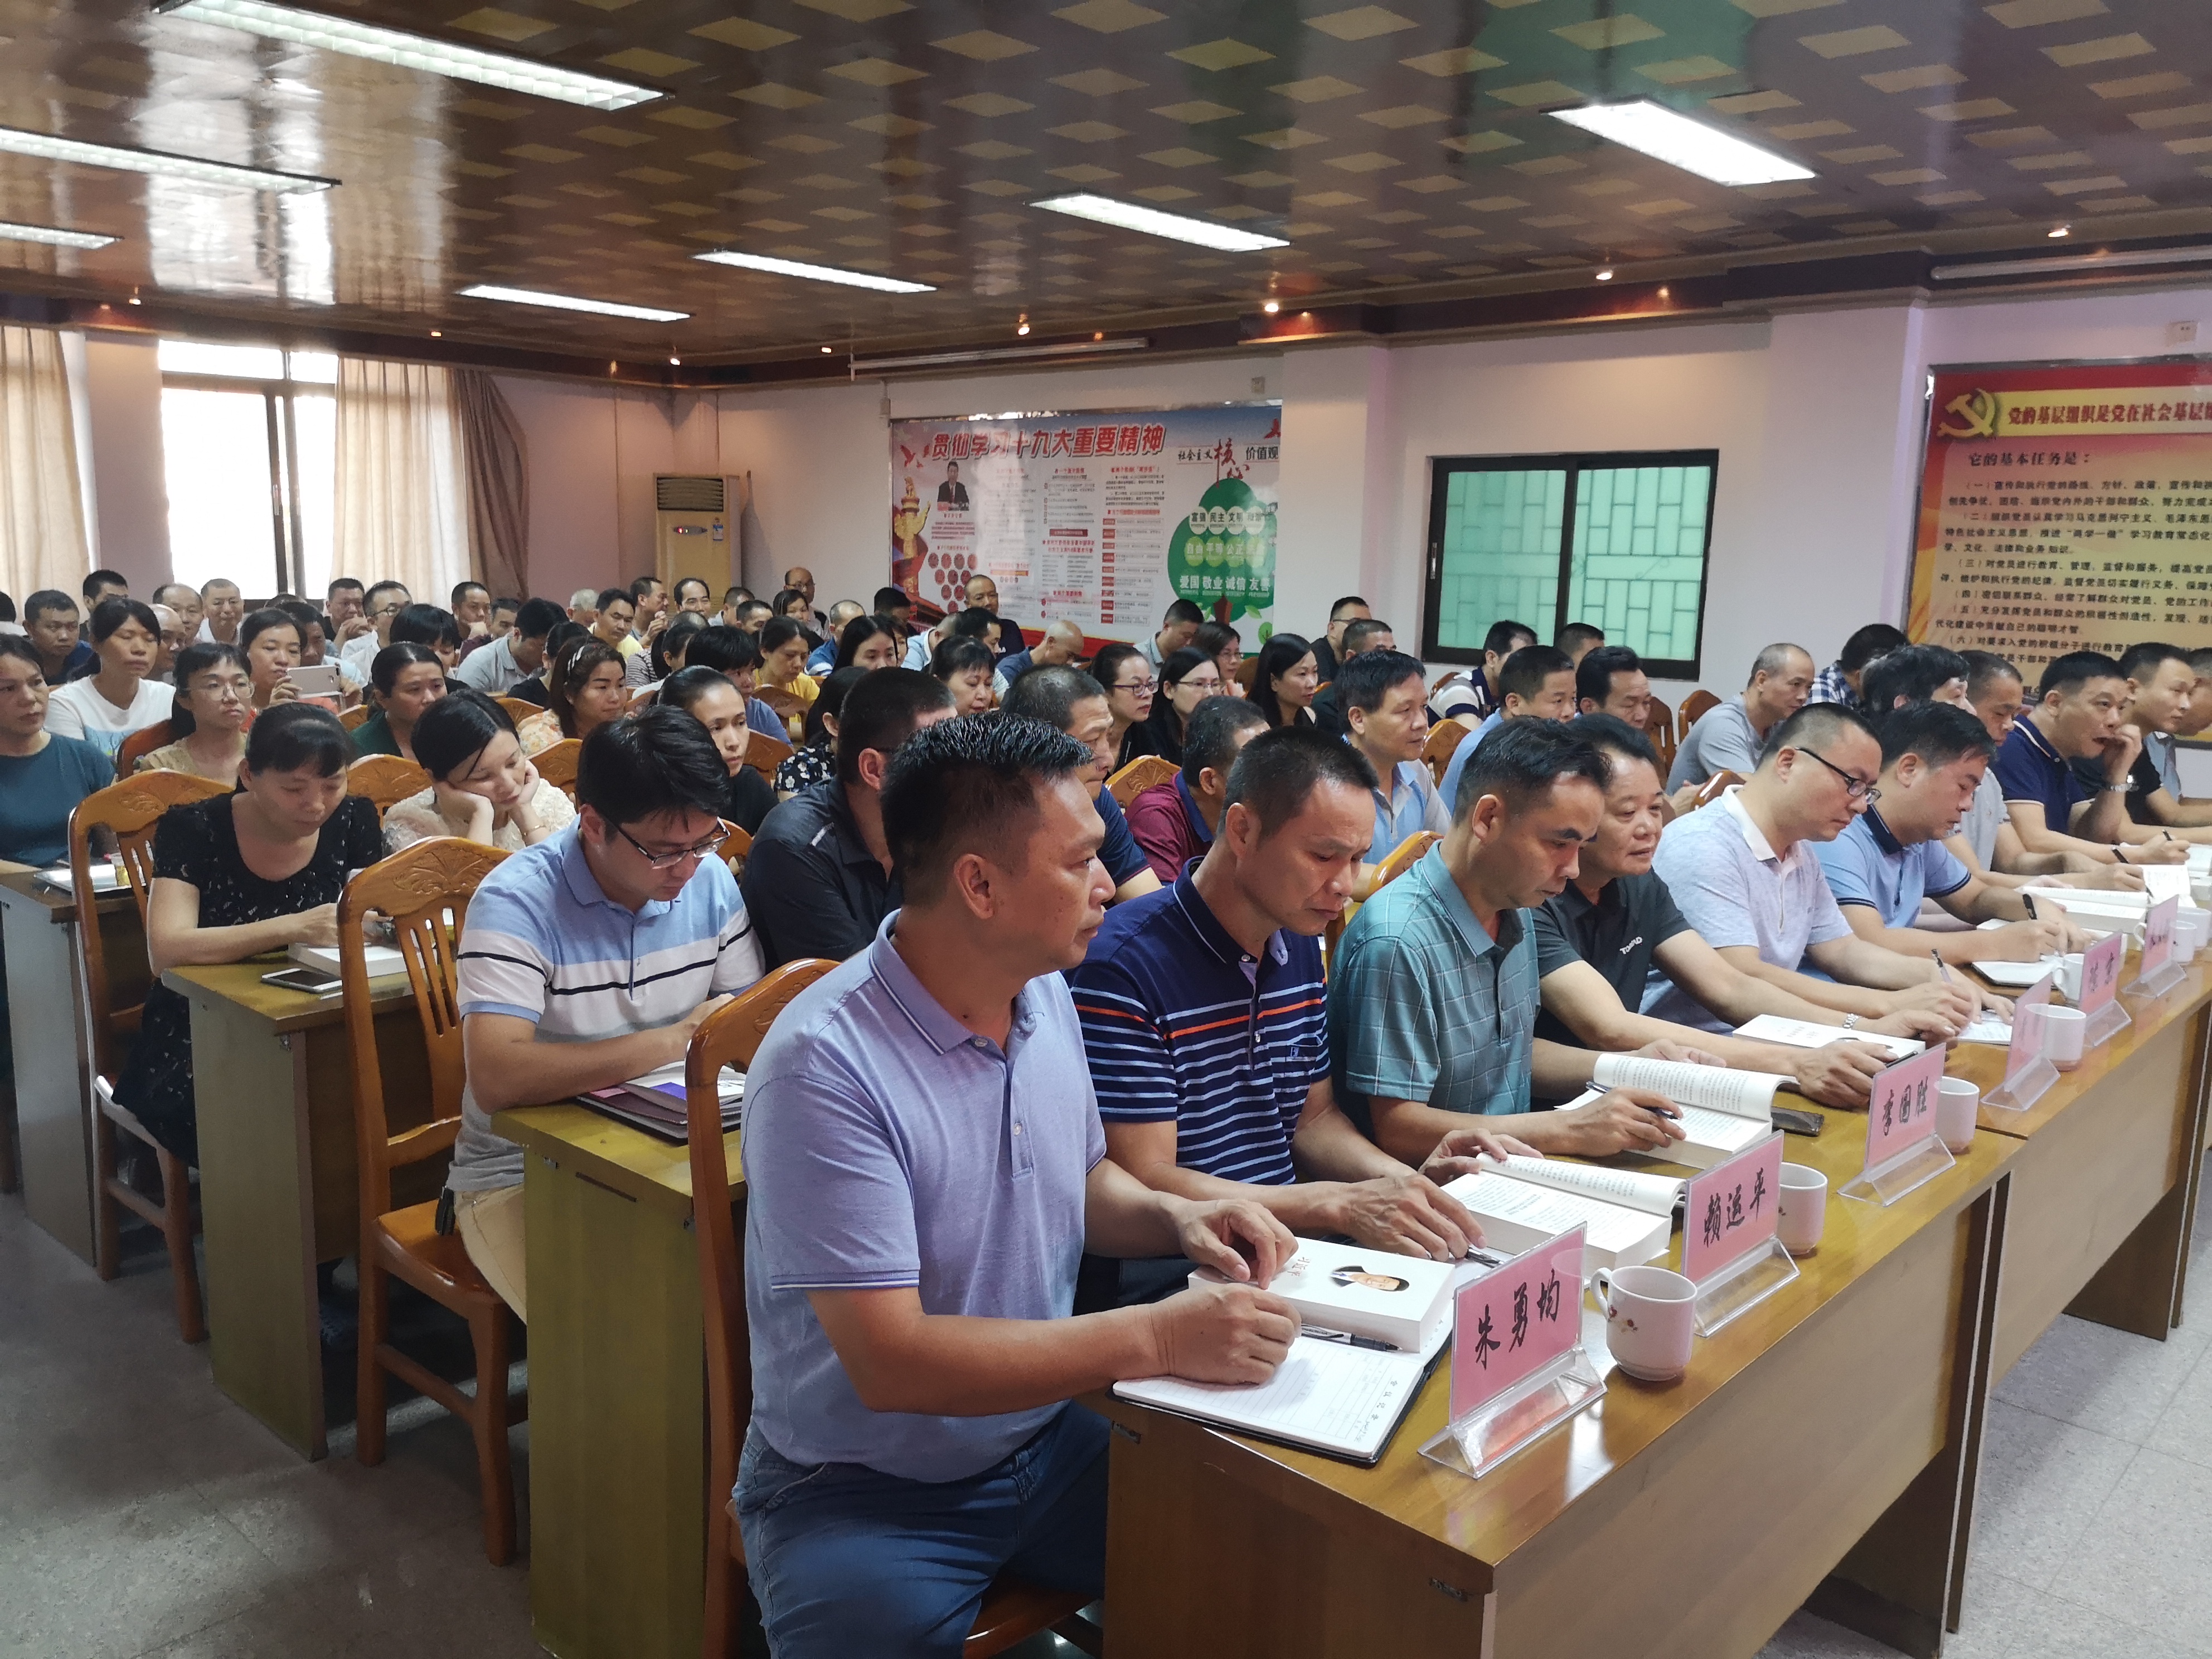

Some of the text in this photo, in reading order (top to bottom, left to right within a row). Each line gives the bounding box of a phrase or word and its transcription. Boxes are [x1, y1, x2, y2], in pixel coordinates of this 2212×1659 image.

[932, 424, 1165, 458] 贯彻学习十九大重要精神
[1178, 449, 1212, 461] 社会主义
[1246, 445, 1279, 460] 价值观
[1209, 512, 1225, 523] 民主
[1180, 575, 1270, 591] 爱国 敬业 诚信 友善
[1619, 937, 1643, 954] TOAD
[1474, 1268, 1561, 1370] 朱勇均
